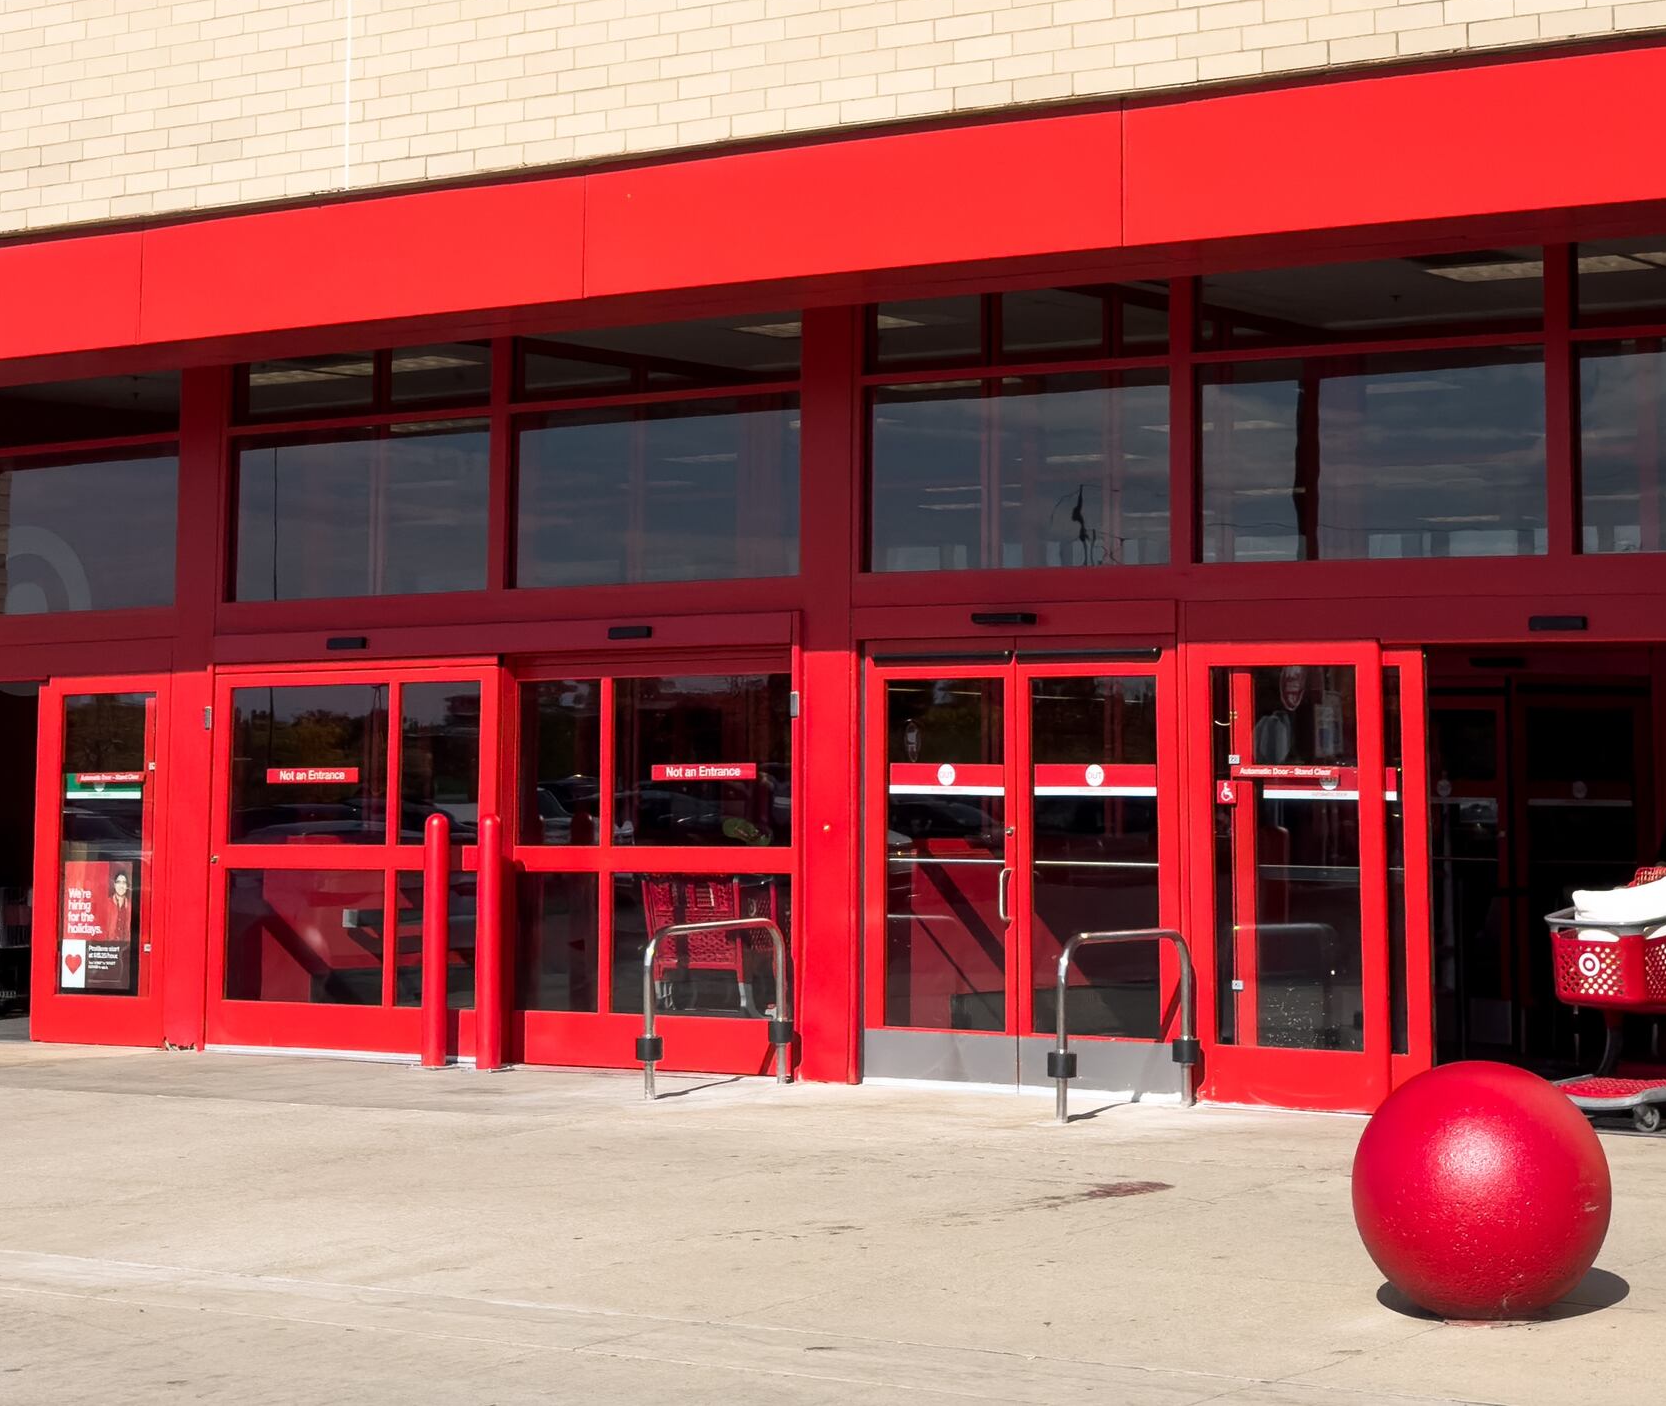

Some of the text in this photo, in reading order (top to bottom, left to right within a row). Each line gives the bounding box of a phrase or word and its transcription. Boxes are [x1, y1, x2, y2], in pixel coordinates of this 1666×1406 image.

[279, 770, 345, 781] Not an Entrance
[665, 766, 741, 777] Not an Entrance
[1087, 771, 1102, 780] OUT
[1239, 767, 1272, 776] Automatic
[1272, 767, 1288, 776] Door
[1294, 767, 1313, 776] Stand
[1314, 767, 1331, 776] Clear
[68, 888, 92, 899] We're
[68, 899, 91, 913] hiring
[68, 911, 94, 922] for the
[67, 924, 103, 936] holidays.
